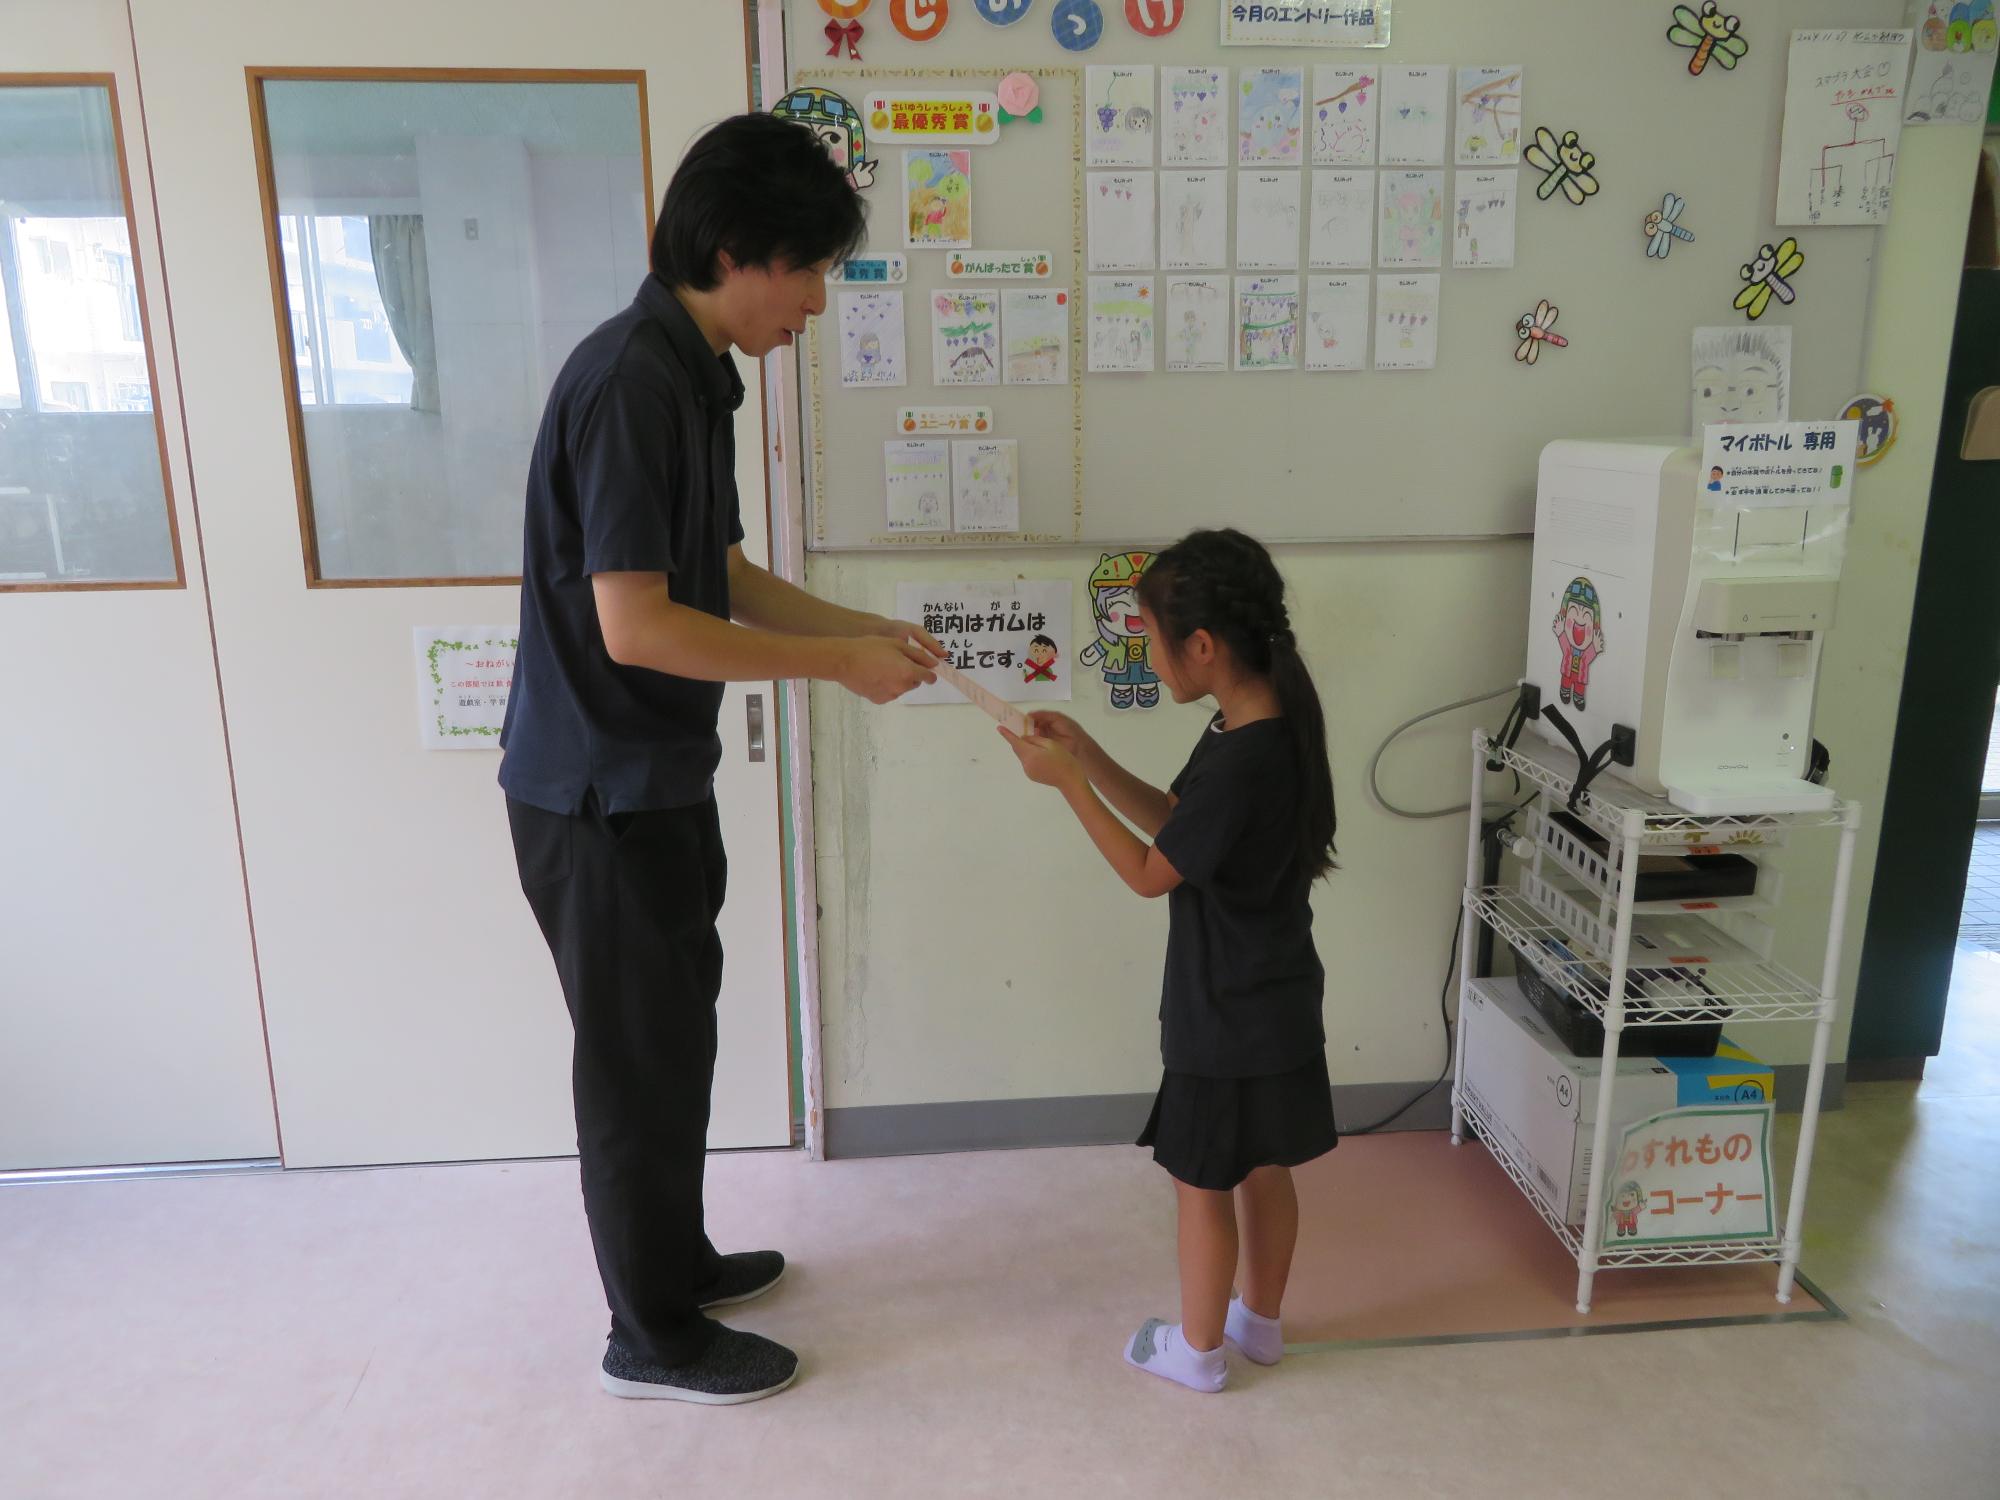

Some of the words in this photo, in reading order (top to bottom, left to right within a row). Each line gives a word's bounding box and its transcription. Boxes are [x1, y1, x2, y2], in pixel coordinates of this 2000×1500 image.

[1231, 5, 1375, 27] 今月のエントリー作品
[891, 103, 973, 112] さいゆうしゅうしょう
[893, 112, 969, 131] 最優秀賞
[965, 261, 1034, 275] がんばったで賞
[1720, 433, 1792, 452] マイボトル
[1803, 431, 1836, 450] 専用
[923, 602, 964, 612] かんない
[923, 613, 1046, 635] 館内はガムは
[1741, 1089, 1757, 1099] A4
[1650, 1182, 1763, 1216] コーナー
